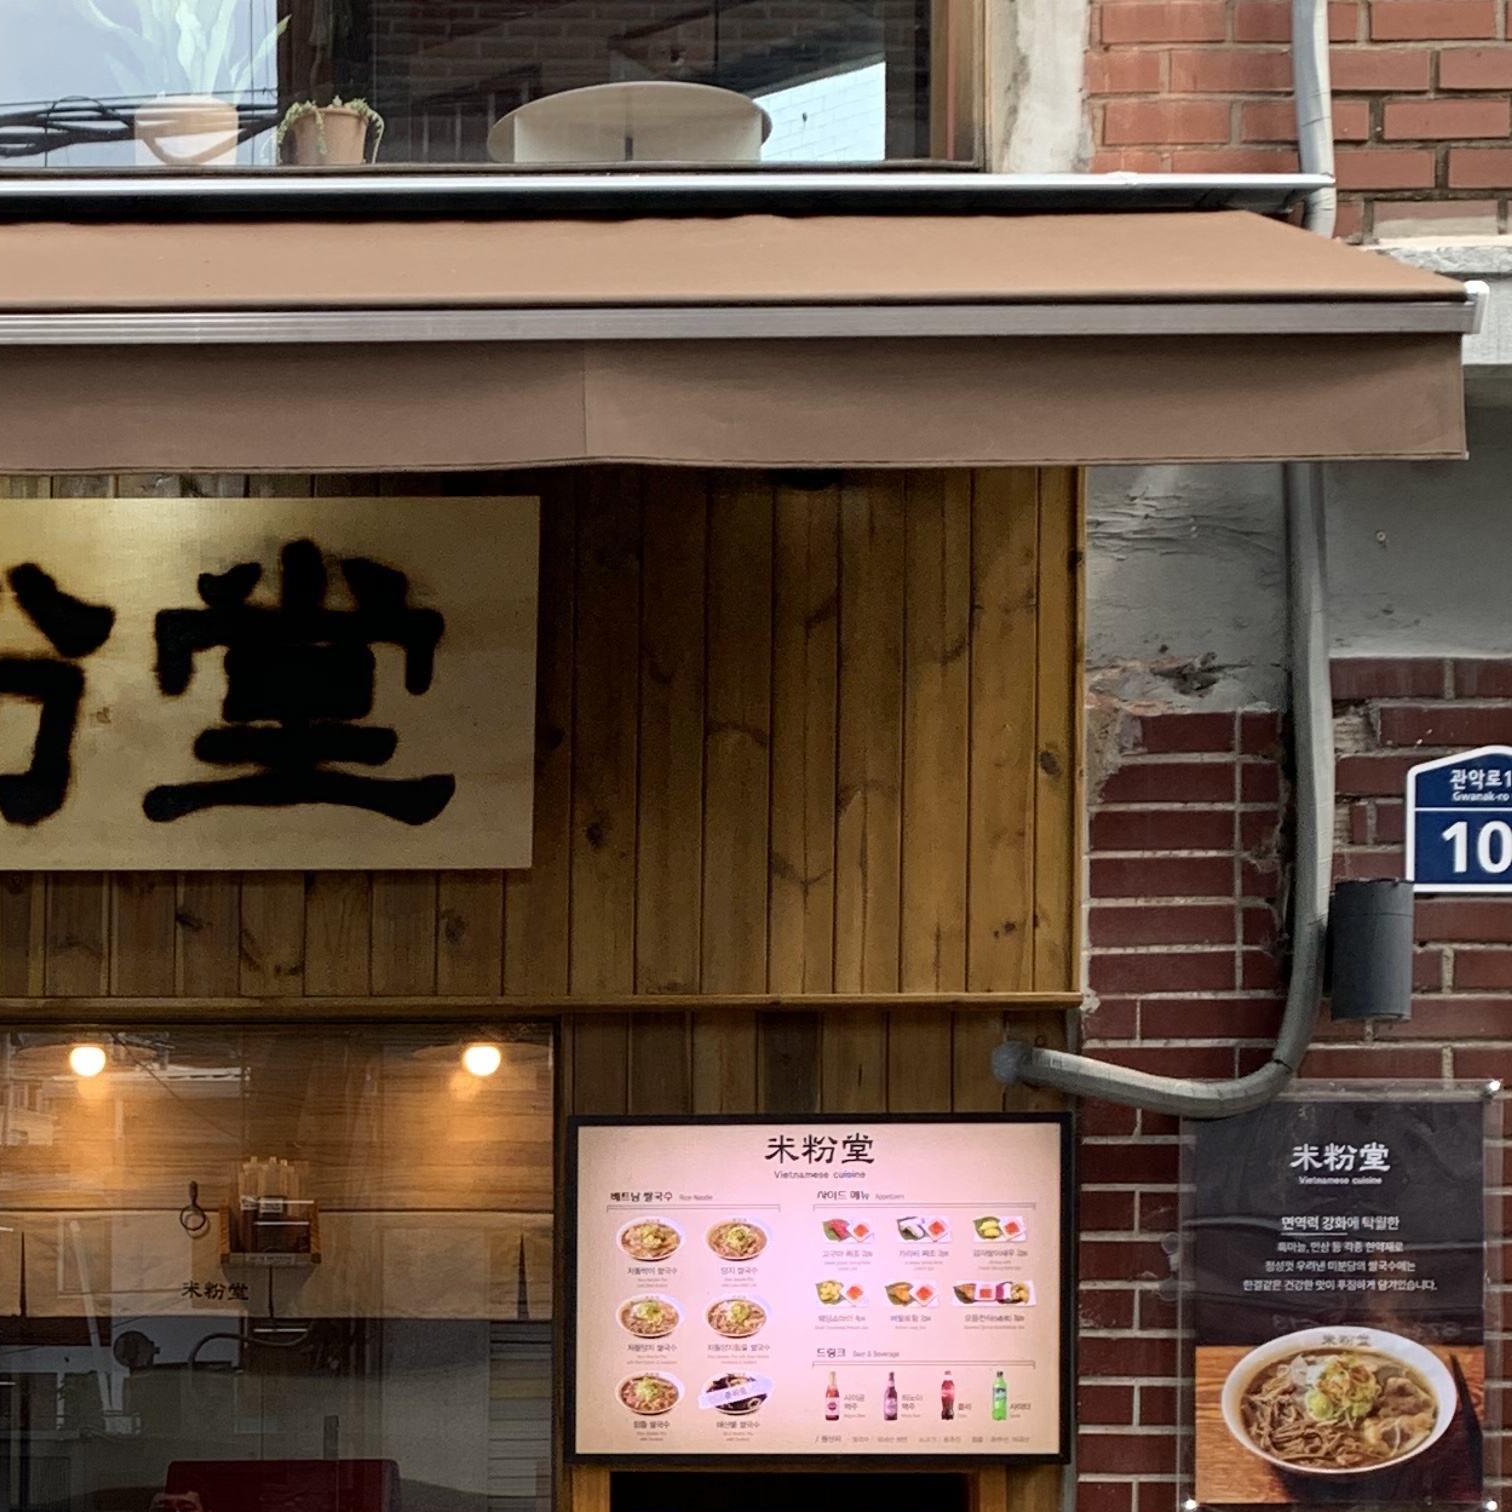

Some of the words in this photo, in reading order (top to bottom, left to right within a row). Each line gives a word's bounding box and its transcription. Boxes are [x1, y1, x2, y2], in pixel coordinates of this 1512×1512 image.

[1452, 791, 1510, 801] Gwanak-ro
[765, 1132, 875, 1164] 米粉堂
[1289, 1141, 1391, 1172] 米粉堂
[774, 1170, 829, 1179] Vietnamese
[833, 1170, 866, 1179] cuisine
[1298, 1176, 1350, 1185] Vietnamese
[1351, 1176, 1383, 1185] cuisine
[610, 1191, 641, 1202] 베트남
[643, 1191, 673, 1202] 쌀국수
[817, 1191, 847, 1200] 사이드
[849, 1191, 870, 1200] 메뉴
[1281, 1216, 1319, 1231] 면역력
[1321, 1216, 1360, 1231] 강화에
[1362, 1216, 1400, 1231] 탁월한
[1327, 1260, 1366, 1272] 미분당의
[1368, 1260, 1416, 1272] 쌀국수에는
[181, 1281, 249, 1300] 米粉堂
[1284, 1279, 1314, 1291] 건강한
[1337, 1279, 1376, 1291] 푸짐하게
[817, 1348, 846, 1358] 드링크
